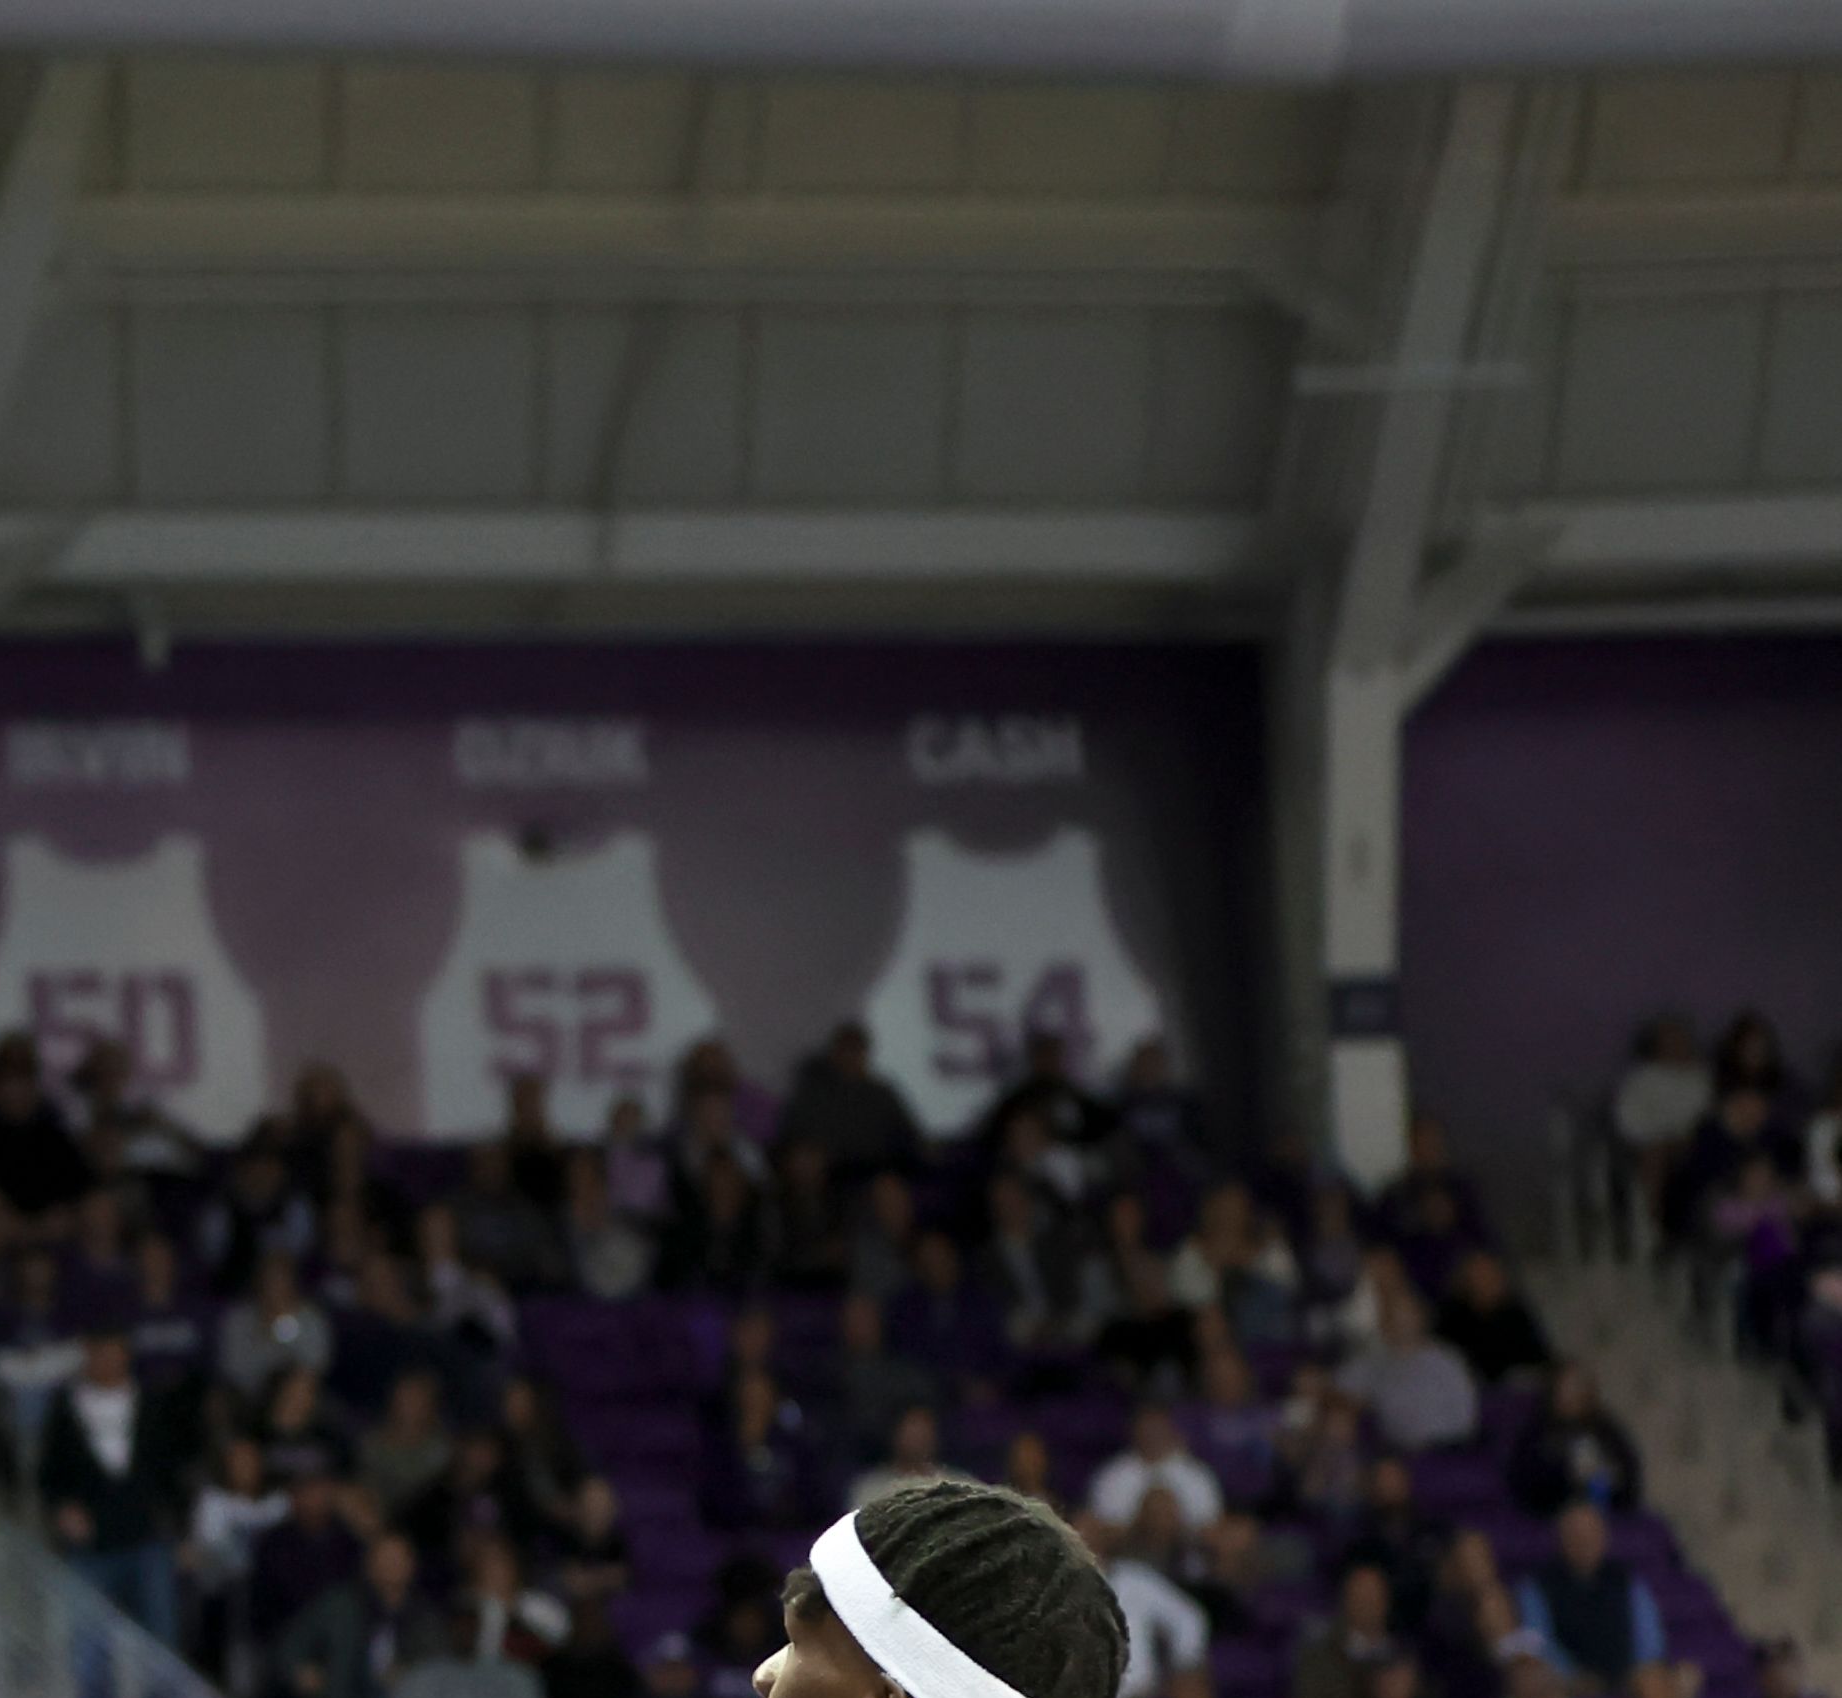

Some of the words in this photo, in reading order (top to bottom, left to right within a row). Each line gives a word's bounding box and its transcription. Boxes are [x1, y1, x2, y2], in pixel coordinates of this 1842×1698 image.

[907, 715, 1085, 780] CASH
[481, 968, 651, 1084] 52
[926, 957, 1100, 1085] 54
